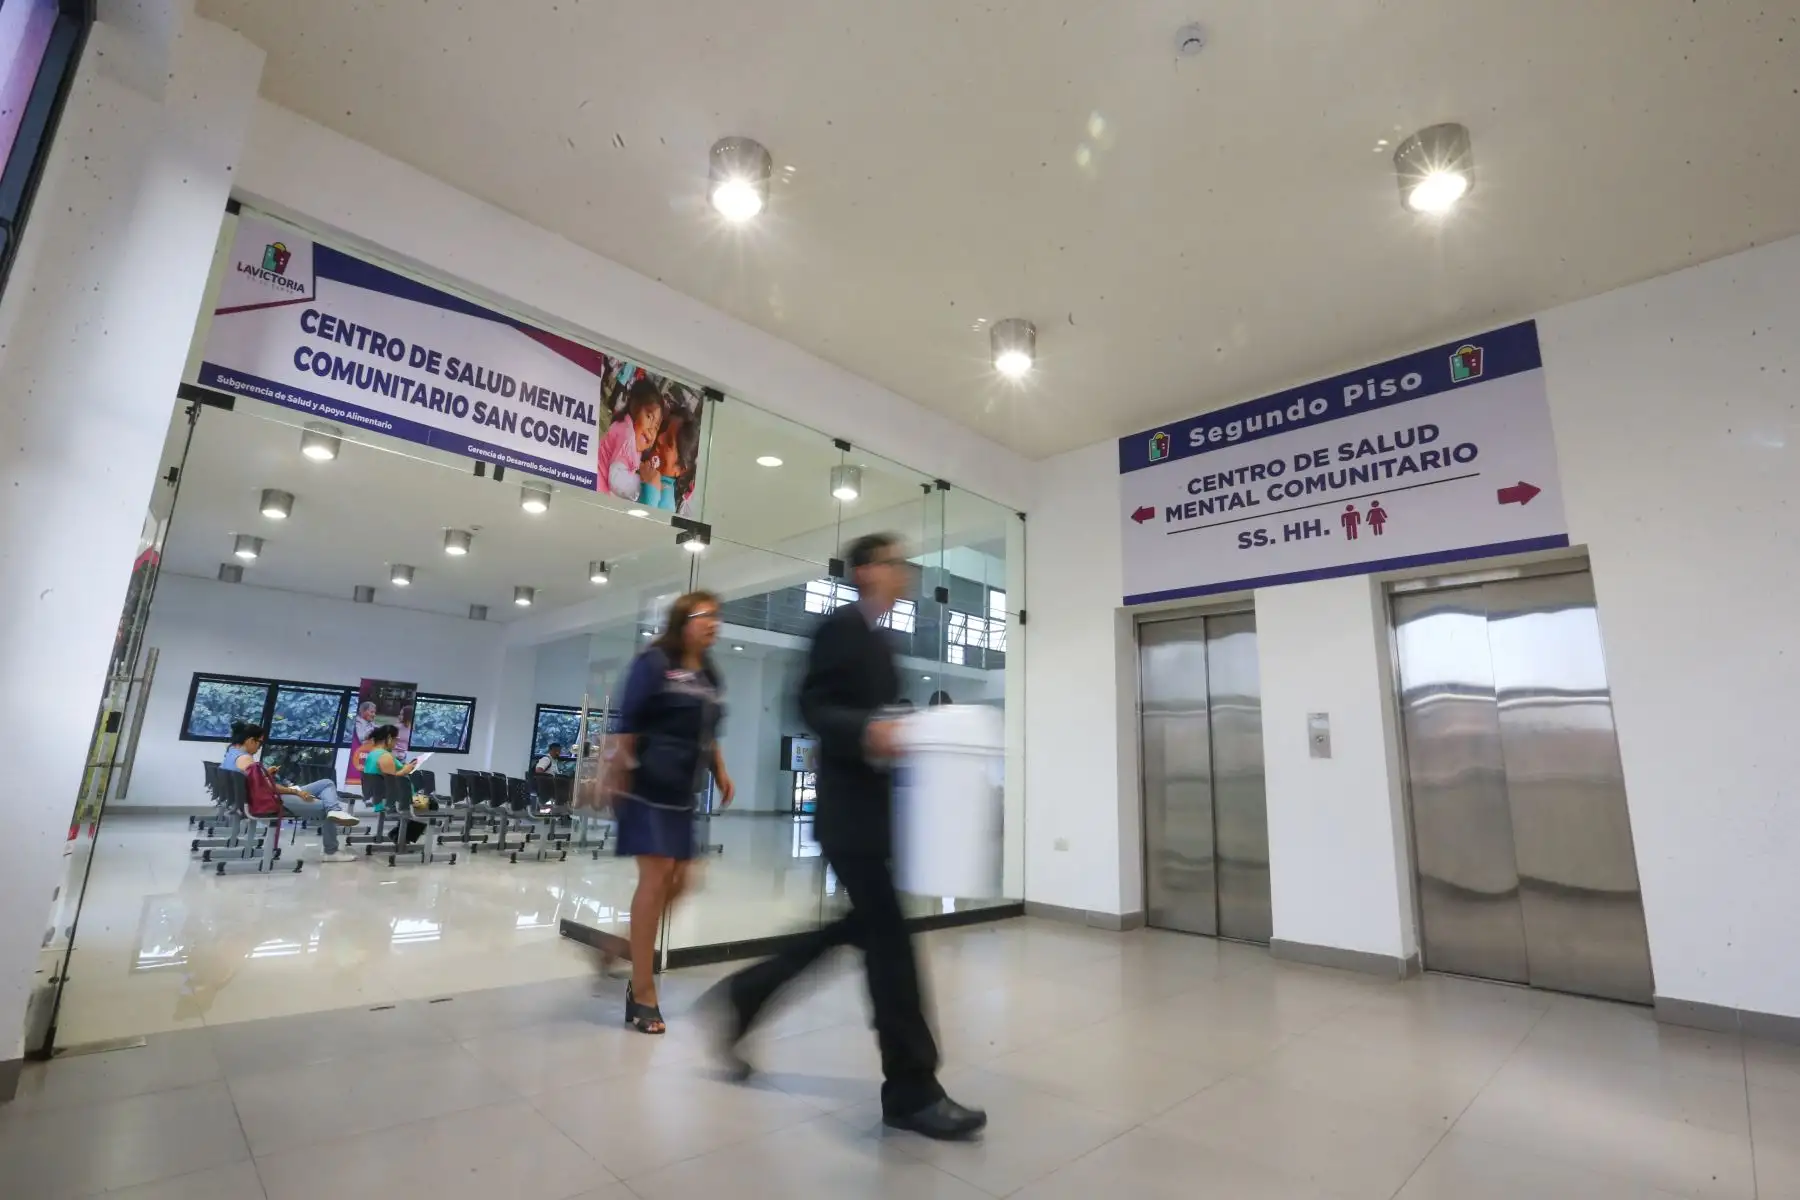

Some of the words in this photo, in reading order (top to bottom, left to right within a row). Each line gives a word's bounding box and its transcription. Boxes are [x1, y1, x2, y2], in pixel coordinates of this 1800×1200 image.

[217, 375, 273, 397] Subgerencia
[275, 391, 286, 400] de
[287, 395, 312, 408] Salud
[312, 402, 320, 410] y
[319, 404, 345, 417] Apoyo
[346, 411, 392, 430] Alimentario
[294, 346, 469, 418] COMUNITARIO
[472, 401, 518, 434] SAN
[520, 416, 589, 455] COSME
[300, 309, 405, 361] CENTRO
[409, 344, 442, 375] DE
[445, 357, 516, 398] SALUD
[519, 381, 596, 426] MENTAL
[1189, 398, 1328, 447] Segundo
[1343, 372, 1422, 407] Piso
[468, 445, 497, 460] Gerencia
[497, 453, 506, 461] de
[506, 455, 538, 470] Desarrollo
[538, 464, 557, 475] Social
[561, 470, 570, 479] de
[576, 474, 592, 485] Mujer
[1165, 490, 1260, 523] MENTAL
[1267, 442, 1478, 501] COMUNITARIO
[1187, 459, 1286, 495] CENTRO
[1294, 445, 1330, 472] DE
[1338, 423, 1440, 462] SALUD
[1238, 528, 1276, 549] SS.
[1283, 517, 1331, 542] HH.
